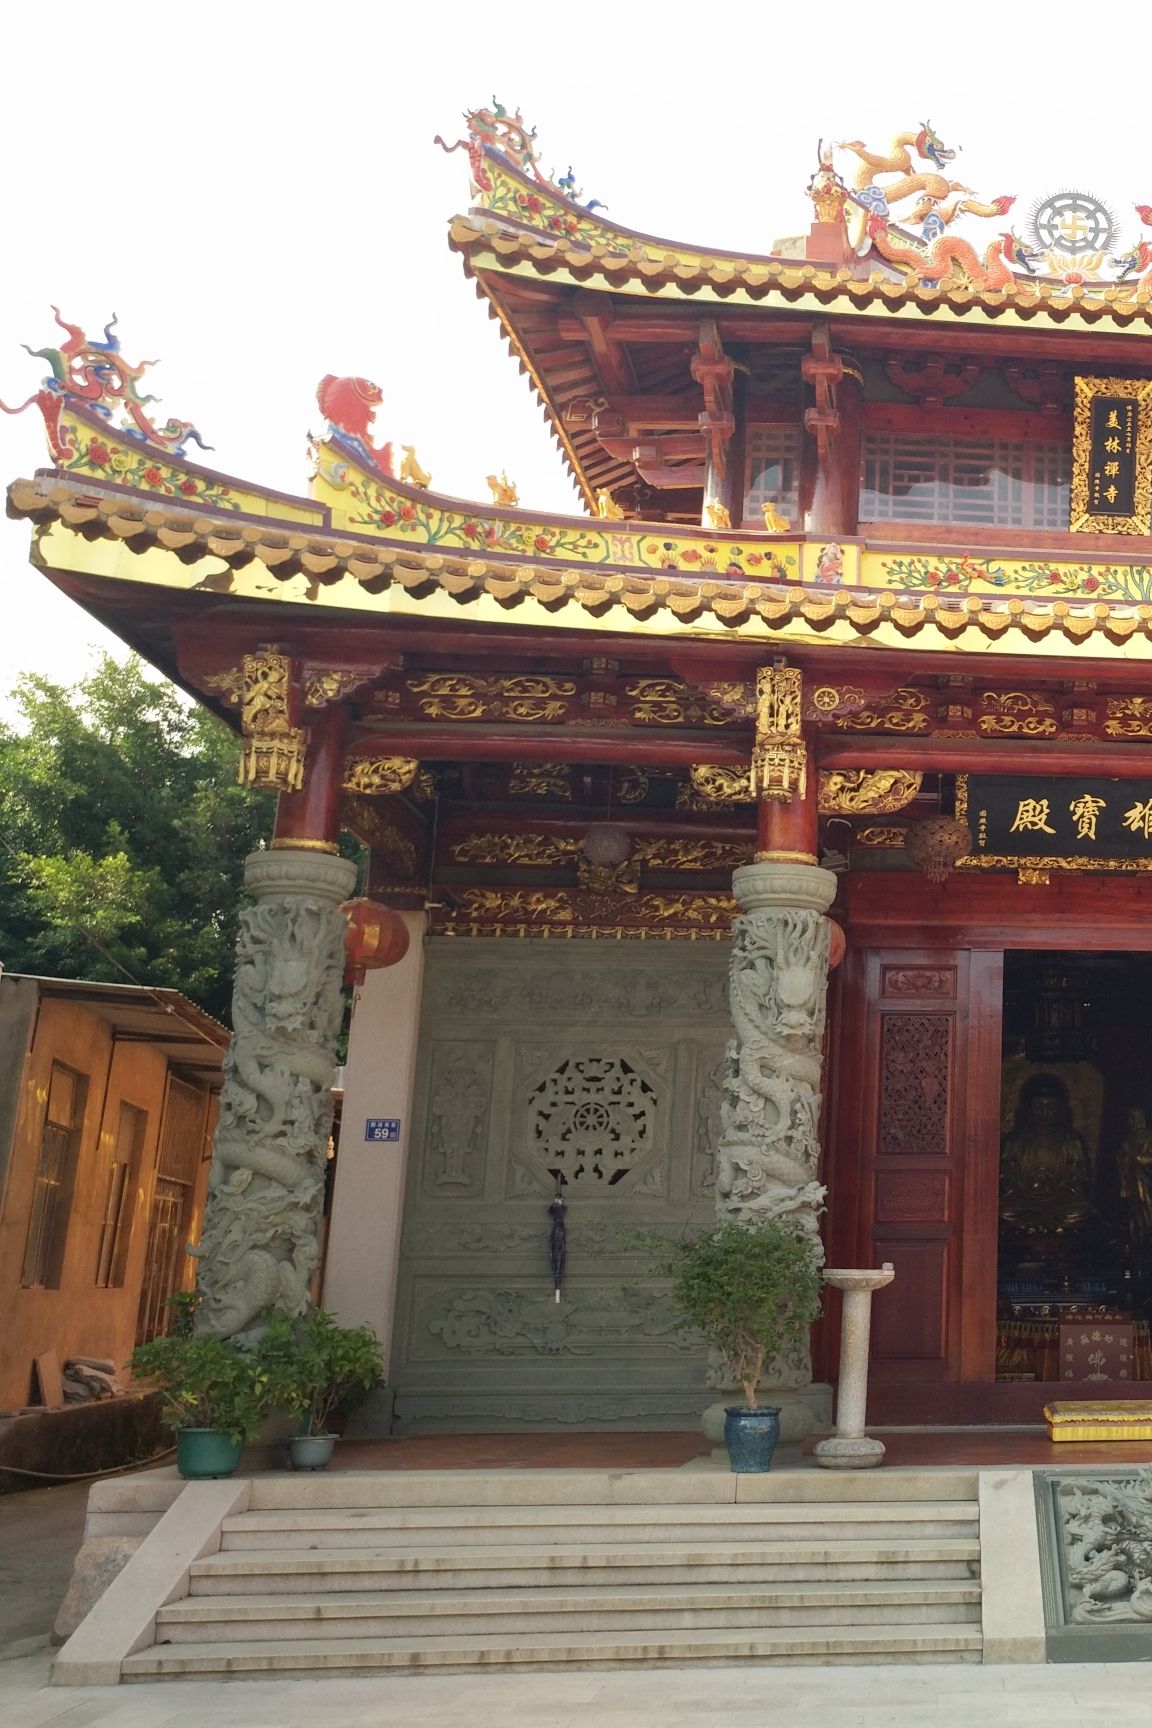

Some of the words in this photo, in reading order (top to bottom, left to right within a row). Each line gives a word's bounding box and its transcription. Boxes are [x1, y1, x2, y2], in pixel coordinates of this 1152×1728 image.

[1103, 410, 1122, 504] 美林禪寺
[374, 1128, 389, 1138] 59
